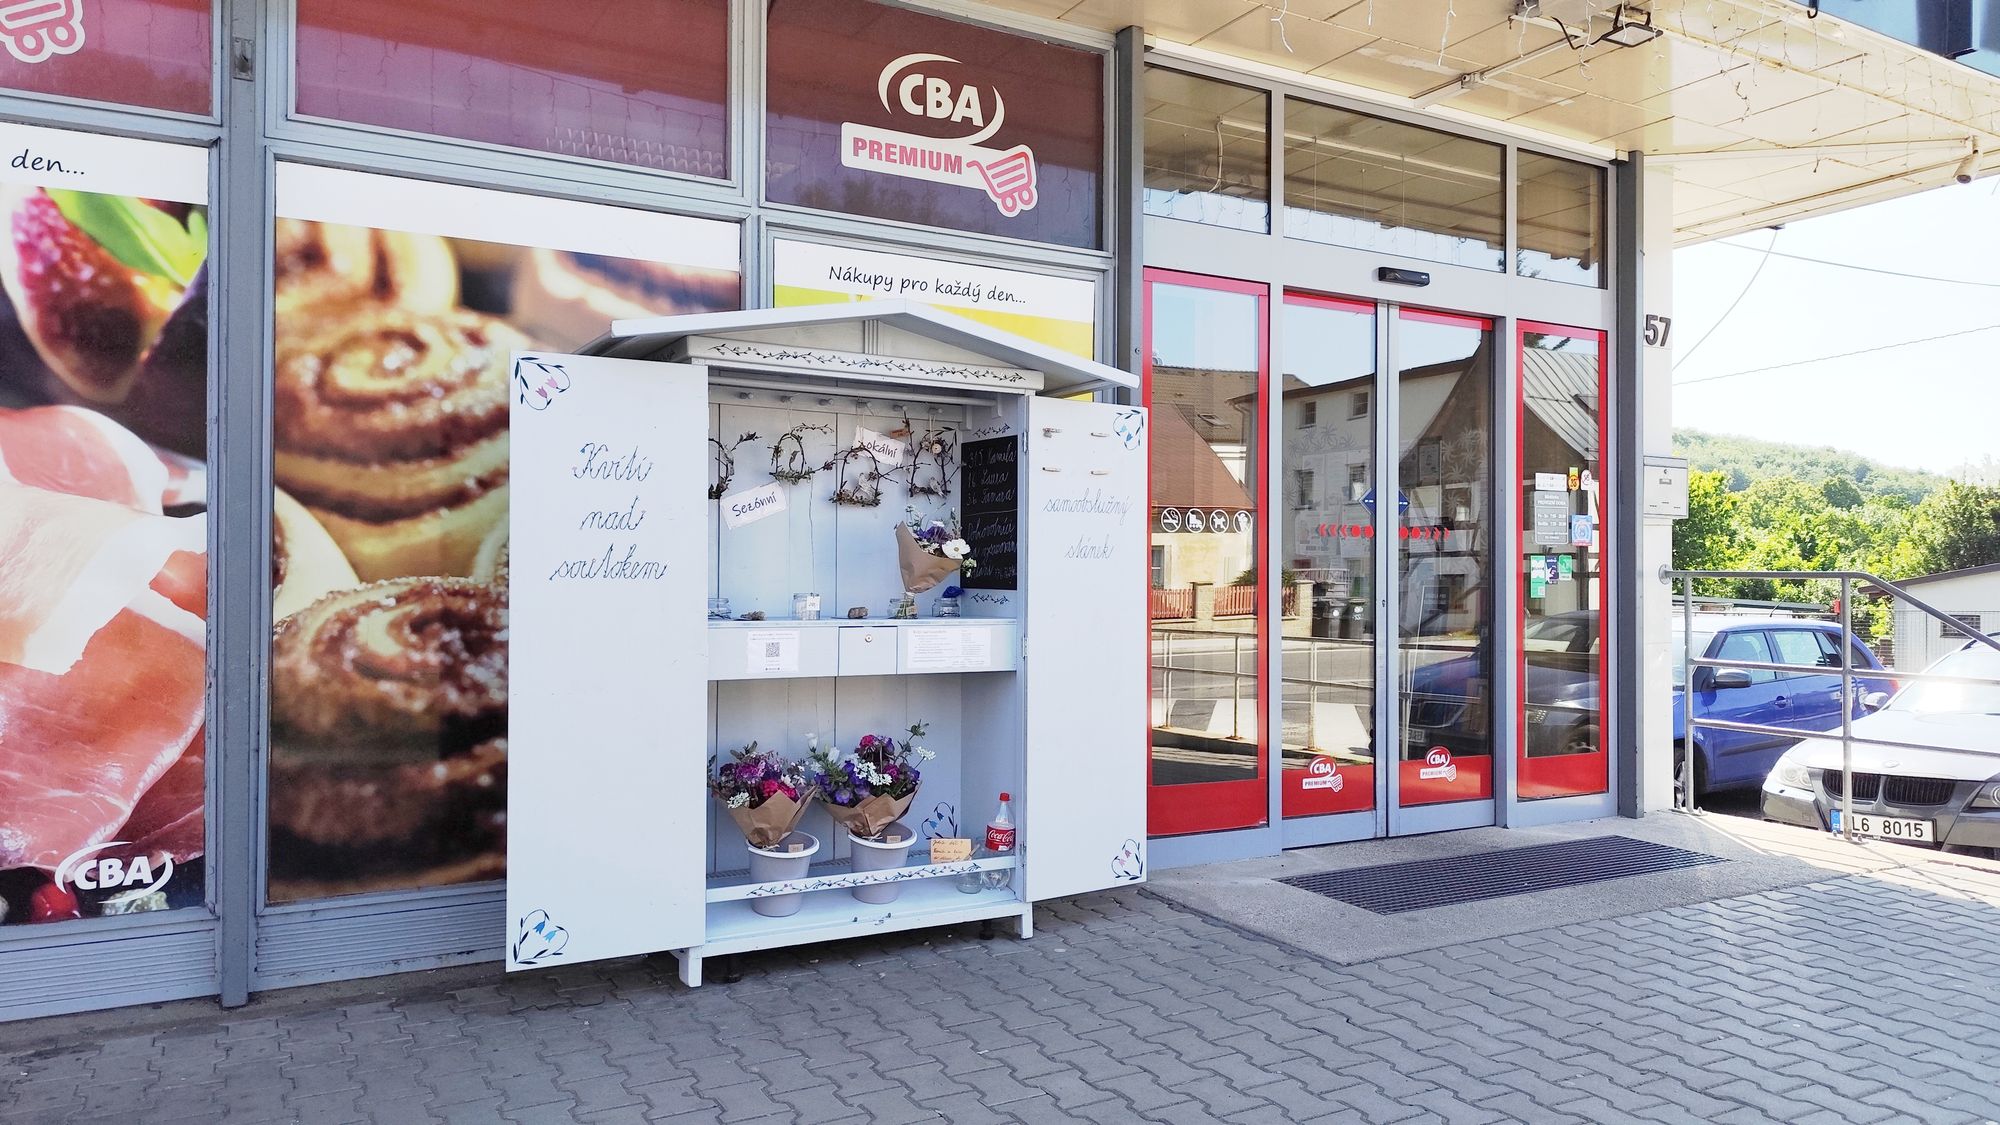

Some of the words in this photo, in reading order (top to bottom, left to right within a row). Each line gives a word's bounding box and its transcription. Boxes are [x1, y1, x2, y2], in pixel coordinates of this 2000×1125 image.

[899, 73, 984, 127] CBA
[11, 148, 85, 175] den...
[852, 136, 963, 175] PREMIUM
[828, 265, 894, 292] Nákupy
[899, 277, 928, 294] pro
[934, 280, 981, 303] každý
[986, 288, 1027, 304] den...
[1643, 314, 1672, 347] 57
[863, 438, 898, 459] okální
[578, 495, 648, 532] nad
[731, 492, 777, 517] Sezónní
[1314, 764, 1332, 774] CBA
[1430, 754, 1447, 765] CBA
[1304, 780, 1327, 788] PREMIUM
[1852, 816, 1870, 832] L6
[1883, 820, 1923, 838] 8015
[74, 856, 154, 890] CBA
